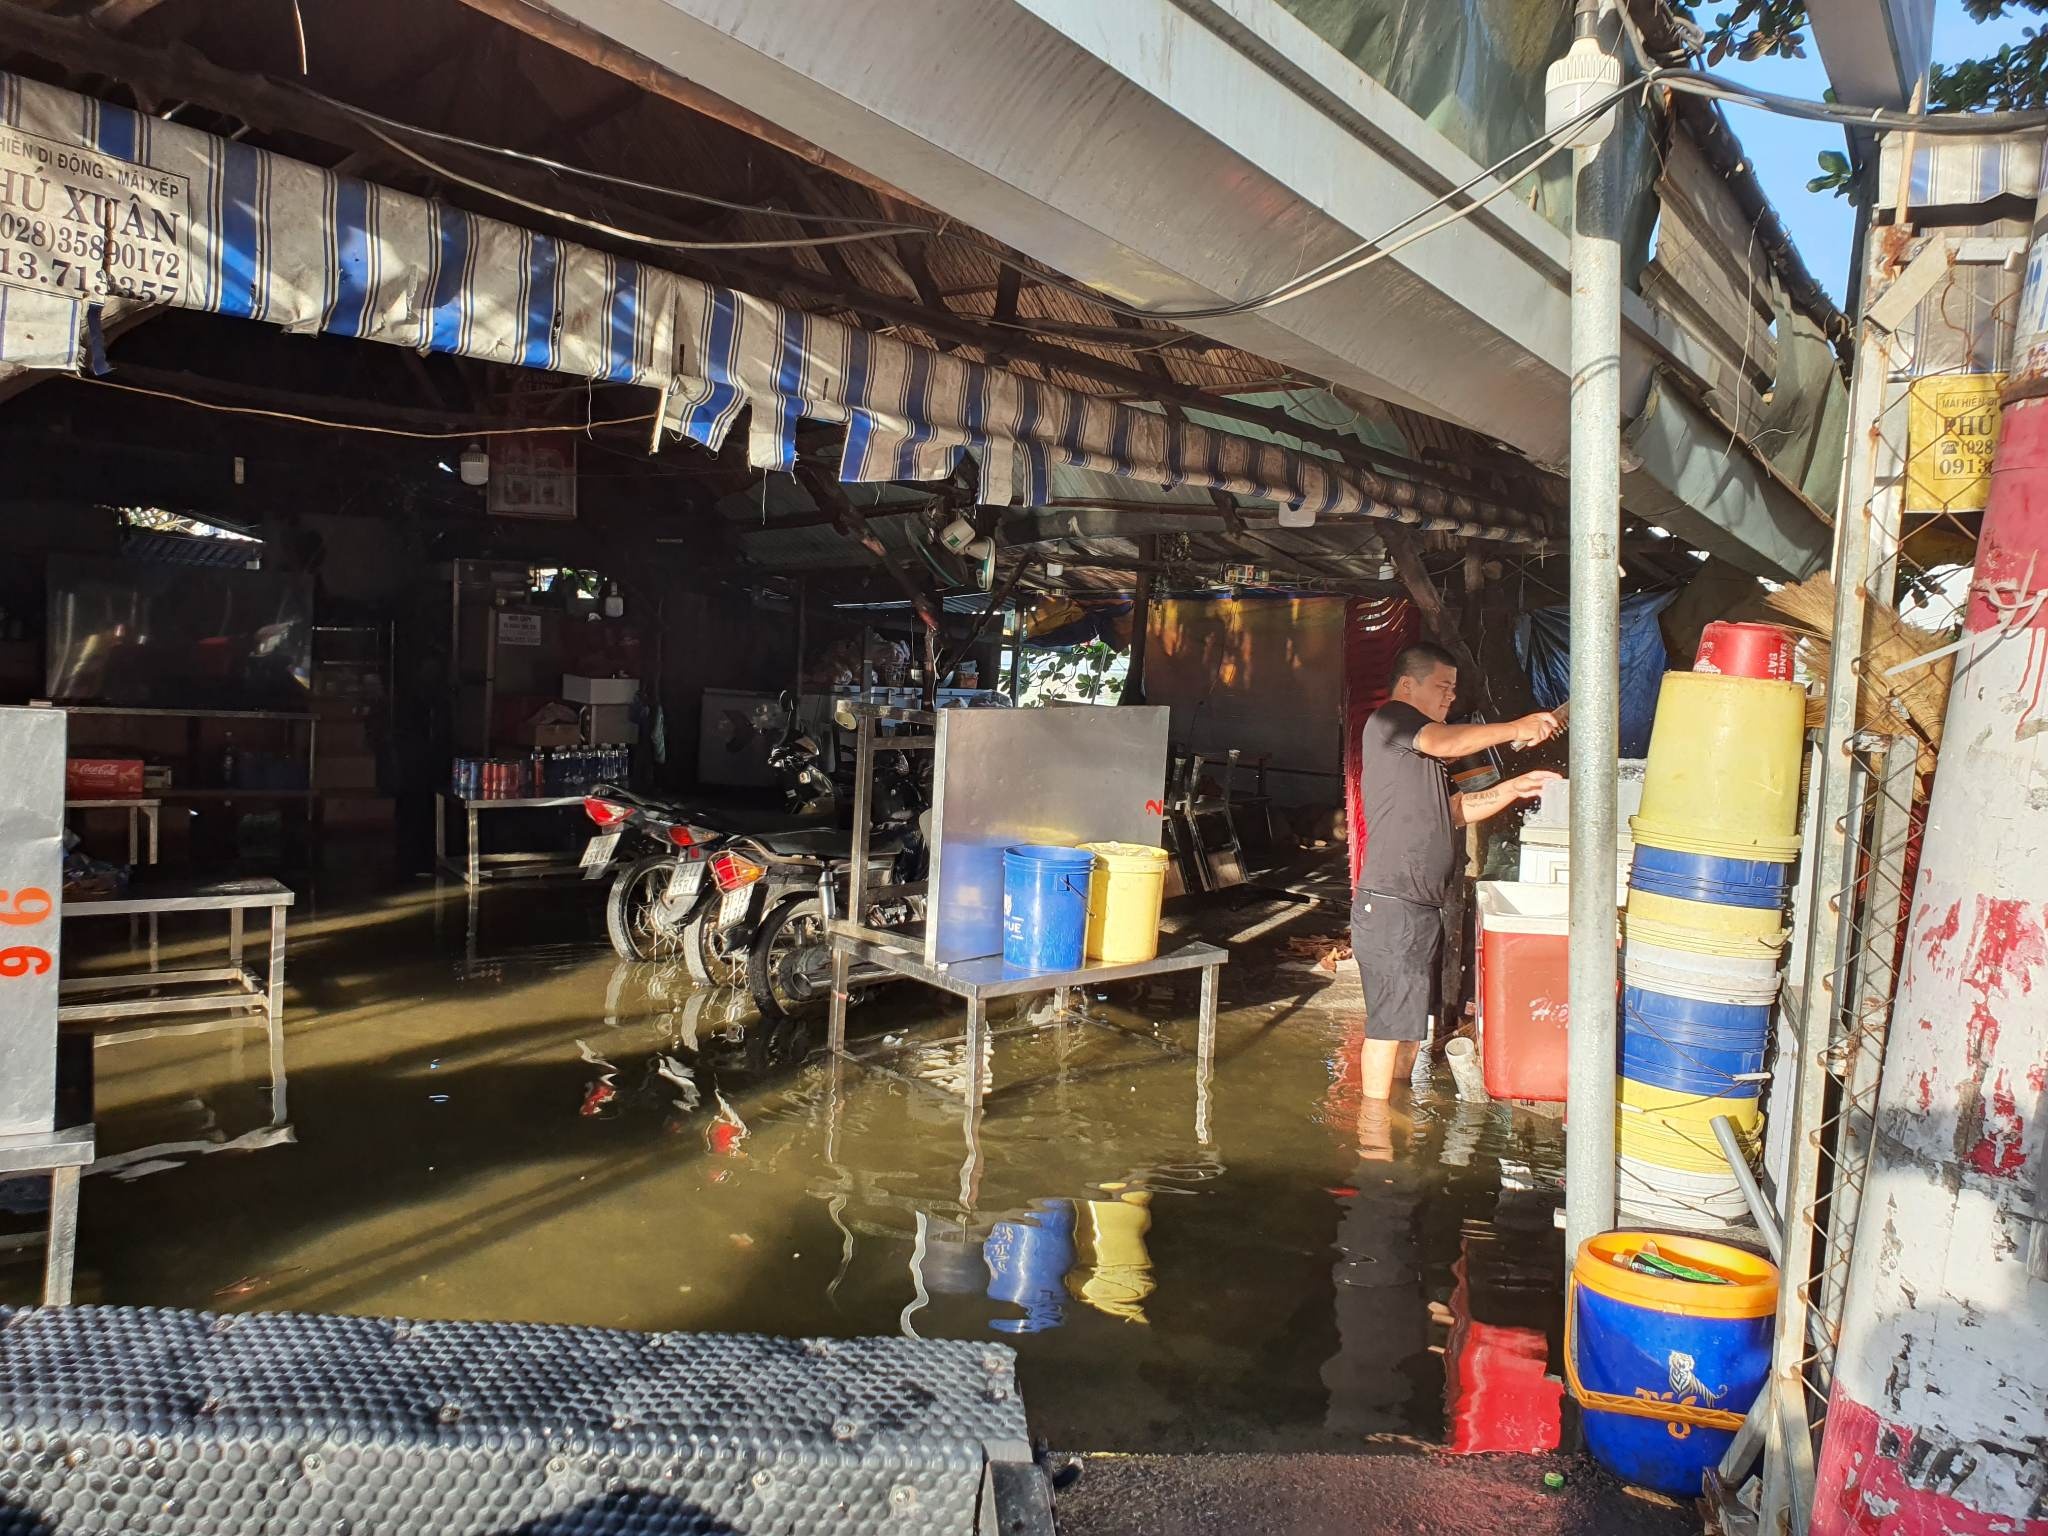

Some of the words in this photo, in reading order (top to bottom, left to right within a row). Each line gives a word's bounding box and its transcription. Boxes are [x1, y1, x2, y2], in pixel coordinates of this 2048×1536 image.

[38, 146, 53, 165] DI
[57, 152, 104, 178] ĐỘNG
[150, 177, 179, 199] XẾP
[62, 185, 180, 246] XUÂN
[1944, 408, 1996, 436] PHÚ
